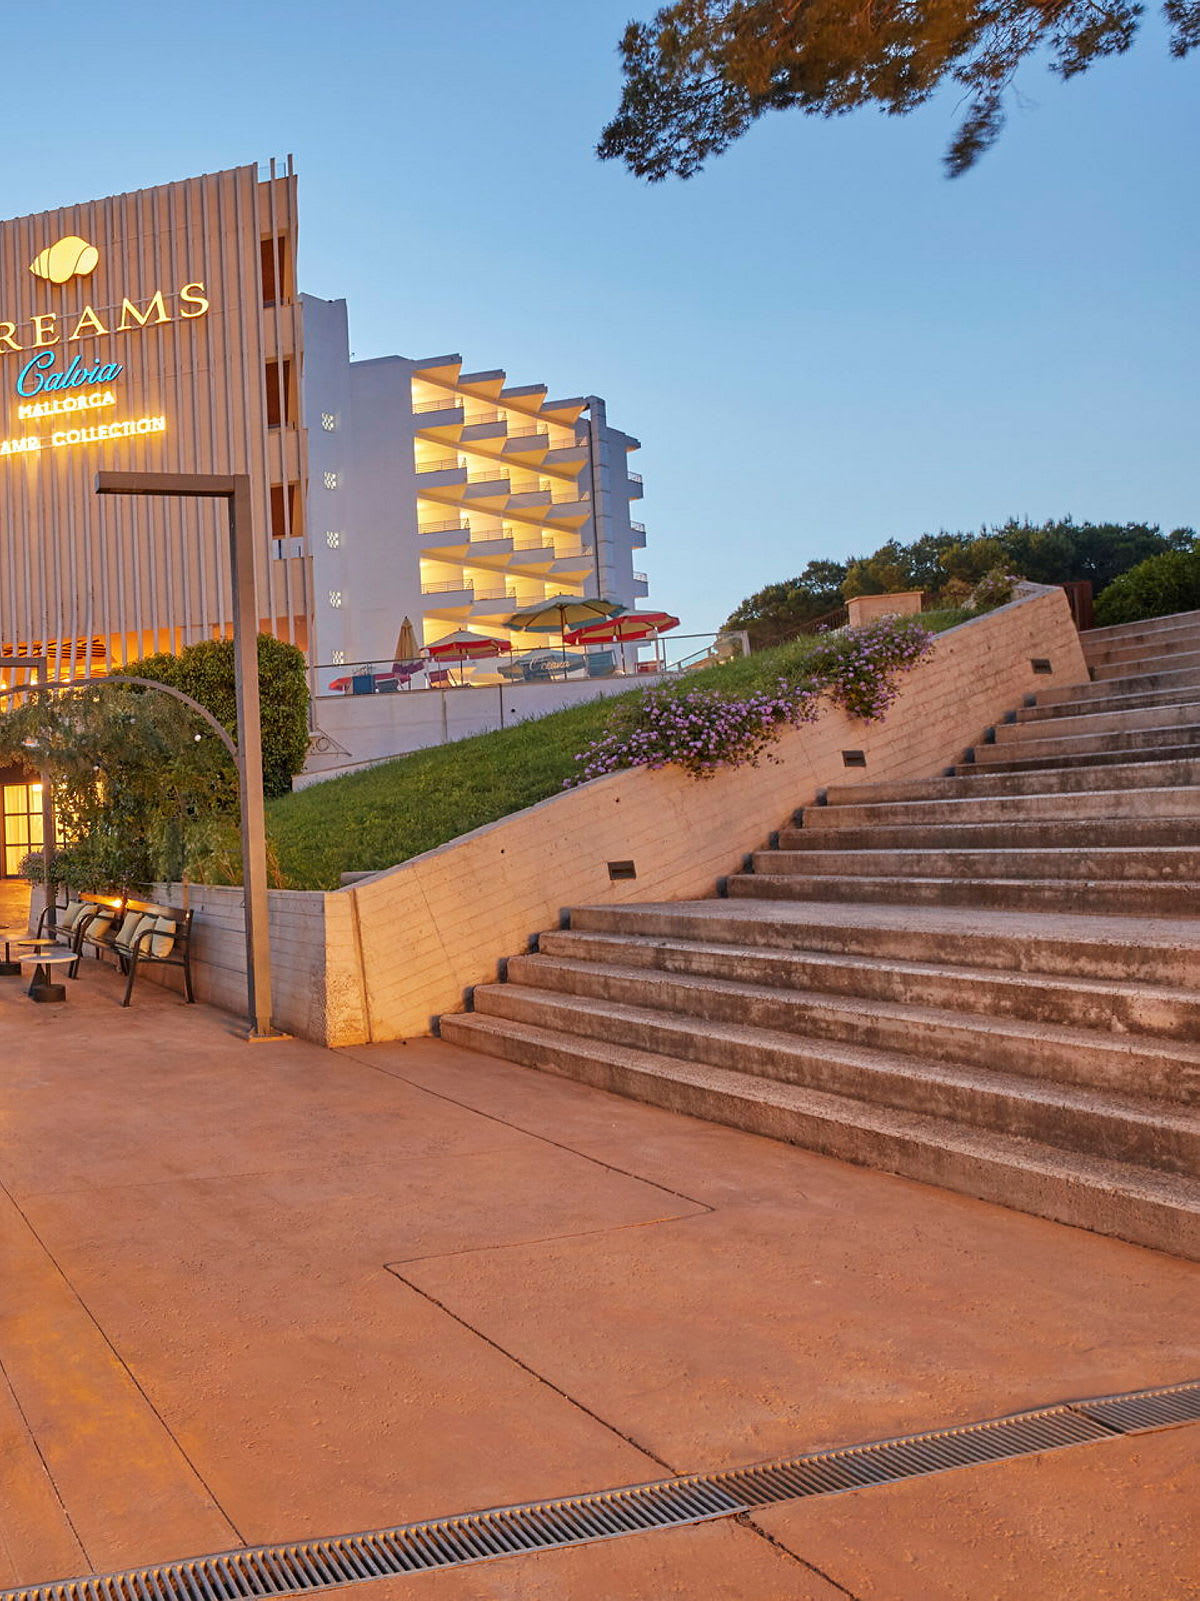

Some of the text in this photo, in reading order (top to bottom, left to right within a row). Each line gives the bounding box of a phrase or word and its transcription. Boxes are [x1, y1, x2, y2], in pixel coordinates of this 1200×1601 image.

[17, 351, 123, 397] Calvia
[18, 391, 115, 420] MALLORCA
[0, 436, 41, 453] AMR
[52, 416, 166, 447] COLLECTION
